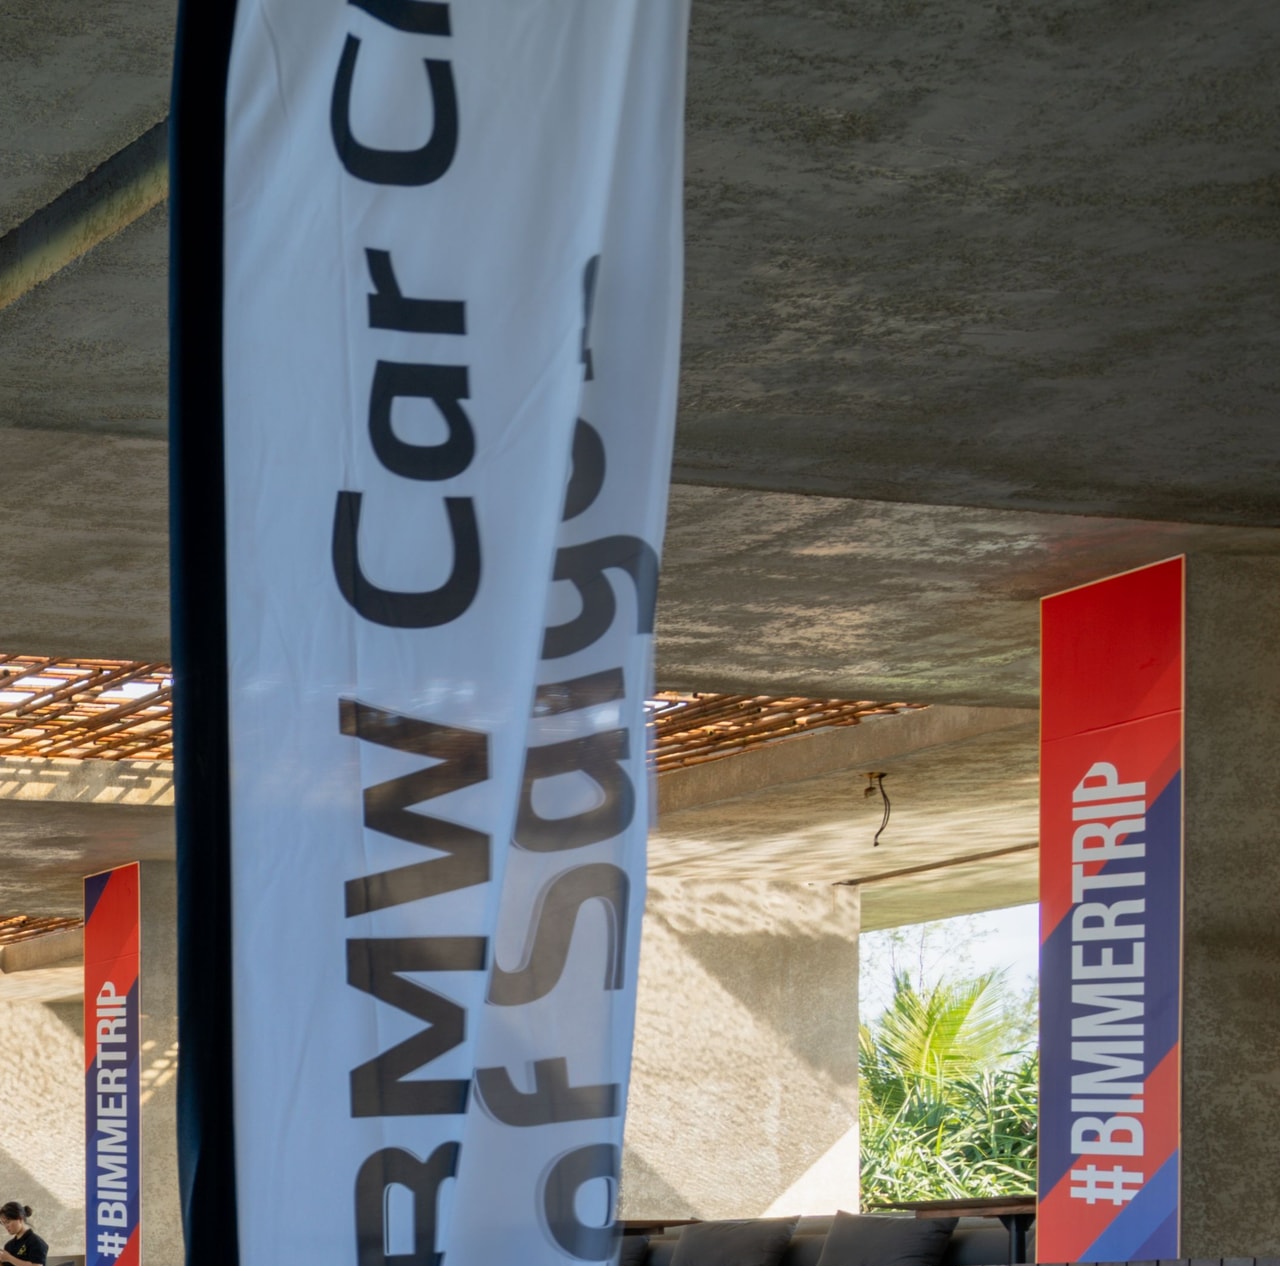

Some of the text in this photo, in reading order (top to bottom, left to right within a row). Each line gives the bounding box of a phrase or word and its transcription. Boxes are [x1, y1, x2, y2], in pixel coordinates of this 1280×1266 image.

[331, 246, 483, 630] Car
[96, 981, 128, 1258] #BIMMERTRIP
[1070, 761, 1147, 1207] #BIMMERTRIP
[472, 1057, 622, 1264] of
